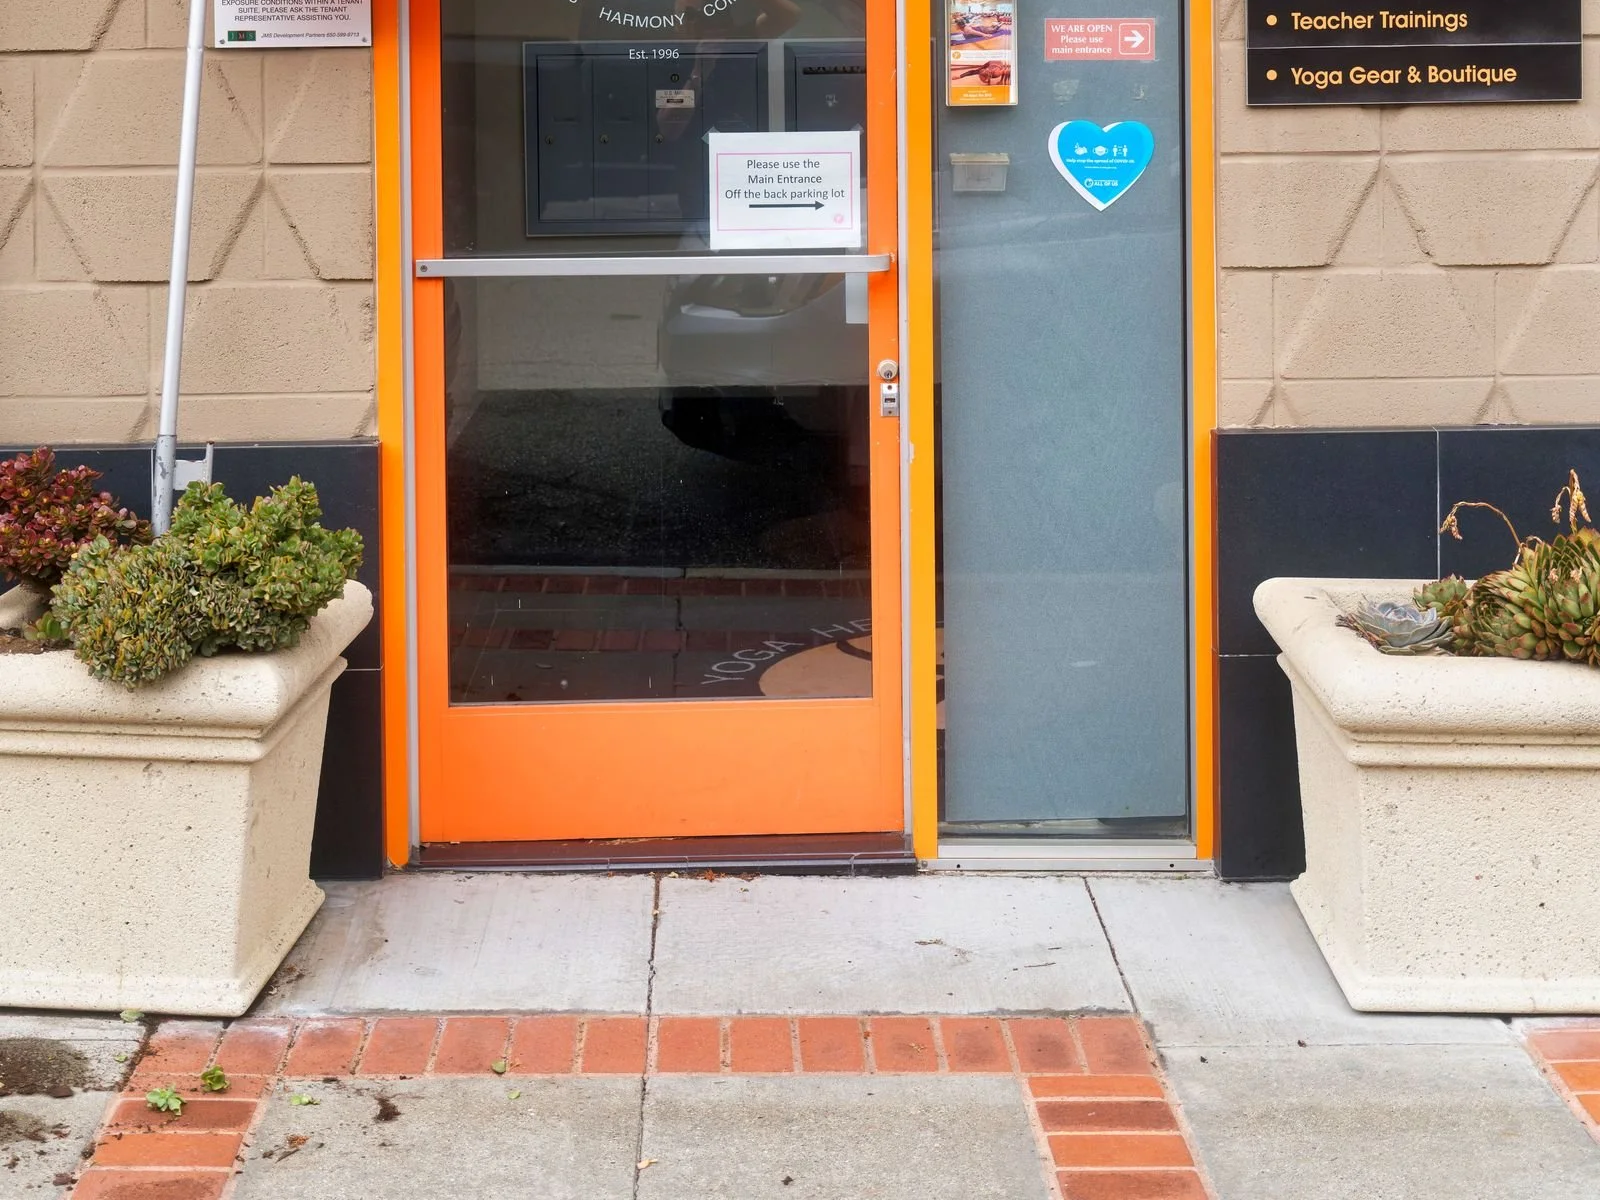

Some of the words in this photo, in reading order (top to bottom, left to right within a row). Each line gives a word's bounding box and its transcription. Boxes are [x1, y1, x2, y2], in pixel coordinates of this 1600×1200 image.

[598, 7, 686, 29] HARMONY
[1291, 11, 1374, 30] Teacher
[1380, 10, 1468, 32] Trainings
[1050, 24, 1065, 33] WE
[1065, 24, 1085, 33] ARE
[1086, 24, 1113, 33] OPEN
[1060, 35, 1086, 44] Please
[1089, 36, 1104, 44] use
[629, 48, 649, 60] Est.
[652, 48, 680, 60] 1996
[1051, 46, 1073, 54] main
[1074, 46, 1113, 54] entrance
[1291, 67, 1343, 89] Yoga
[1349, 66, 1402, 85] Gear
[1407, 66, 1422, 84] &
[1428, 65, 1517, 86] Boutique
[747, 159, 780, 169] Please
[782, 161, 801, 169] use
[803, 159, 821, 169] the
[748, 174, 775, 184] Main
[777, 174, 823, 184] Entrance
[725, 189, 742, 199] Off
[743, 189, 761, 199] the
[763, 189, 788, 199] back
[790, 189, 829, 201] parking
[830, 189, 846, 199] lot
[701, 640, 805, 685] YOGA
